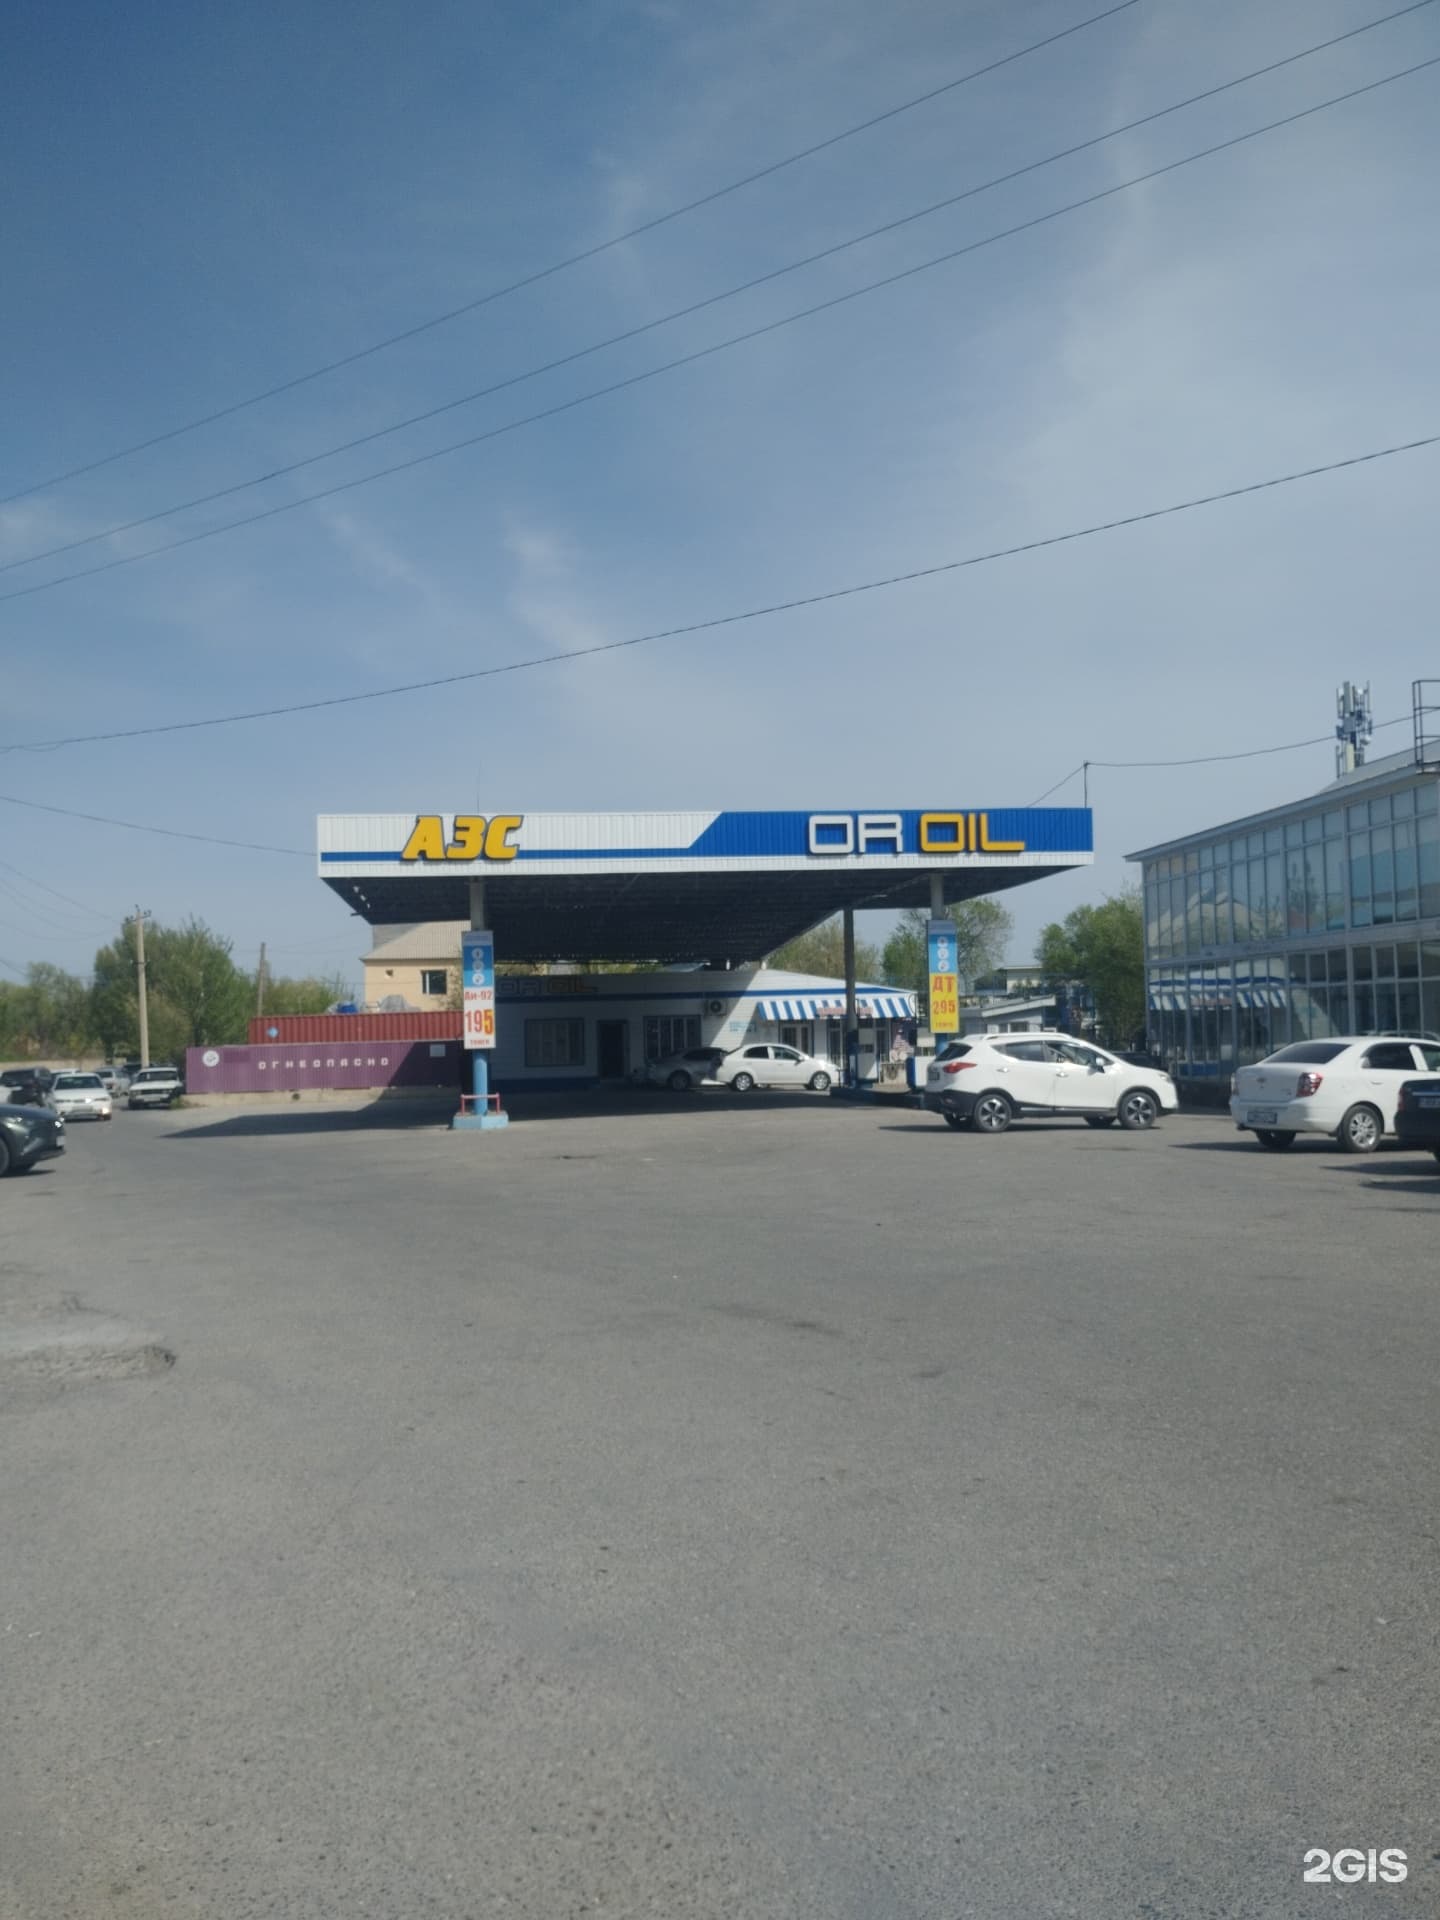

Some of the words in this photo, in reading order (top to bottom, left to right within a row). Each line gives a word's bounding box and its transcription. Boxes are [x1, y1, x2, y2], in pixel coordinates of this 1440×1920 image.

[401, 814, 524, 861] АЗС
[808, 813, 904, 855] OR
[920, 813, 1025, 853] OIL
[464, 1009, 494, 1035] 195
[258, 1057, 389, 1070] ОГНЕОПАСНО
